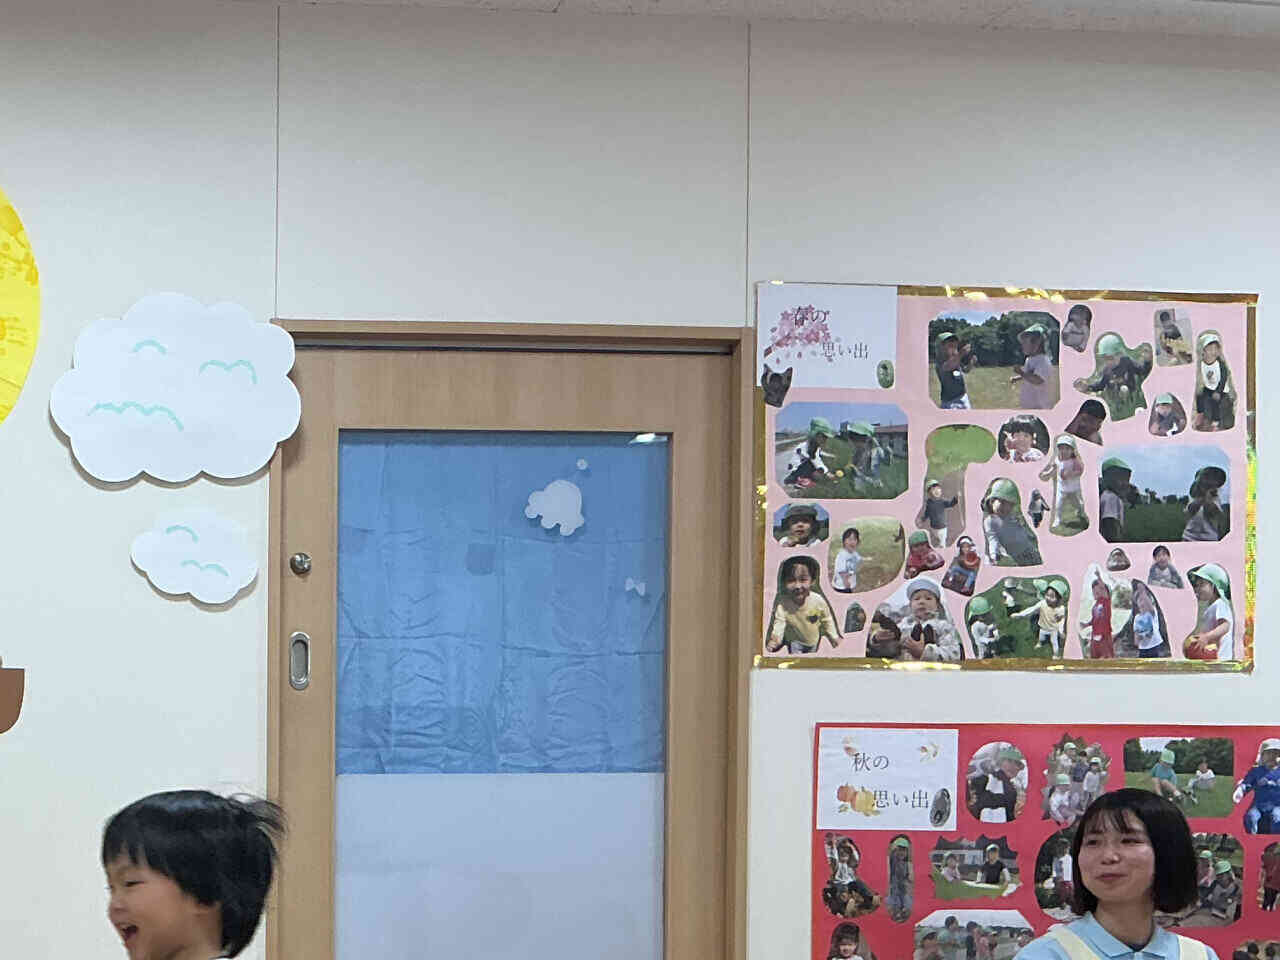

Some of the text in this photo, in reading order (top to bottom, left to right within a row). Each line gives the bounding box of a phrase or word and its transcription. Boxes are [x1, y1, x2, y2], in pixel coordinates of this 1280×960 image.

[821, 342, 869, 360] 思い出
[853, 753, 889, 771] 秋の
[873, 790, 929, 808] 思い出
